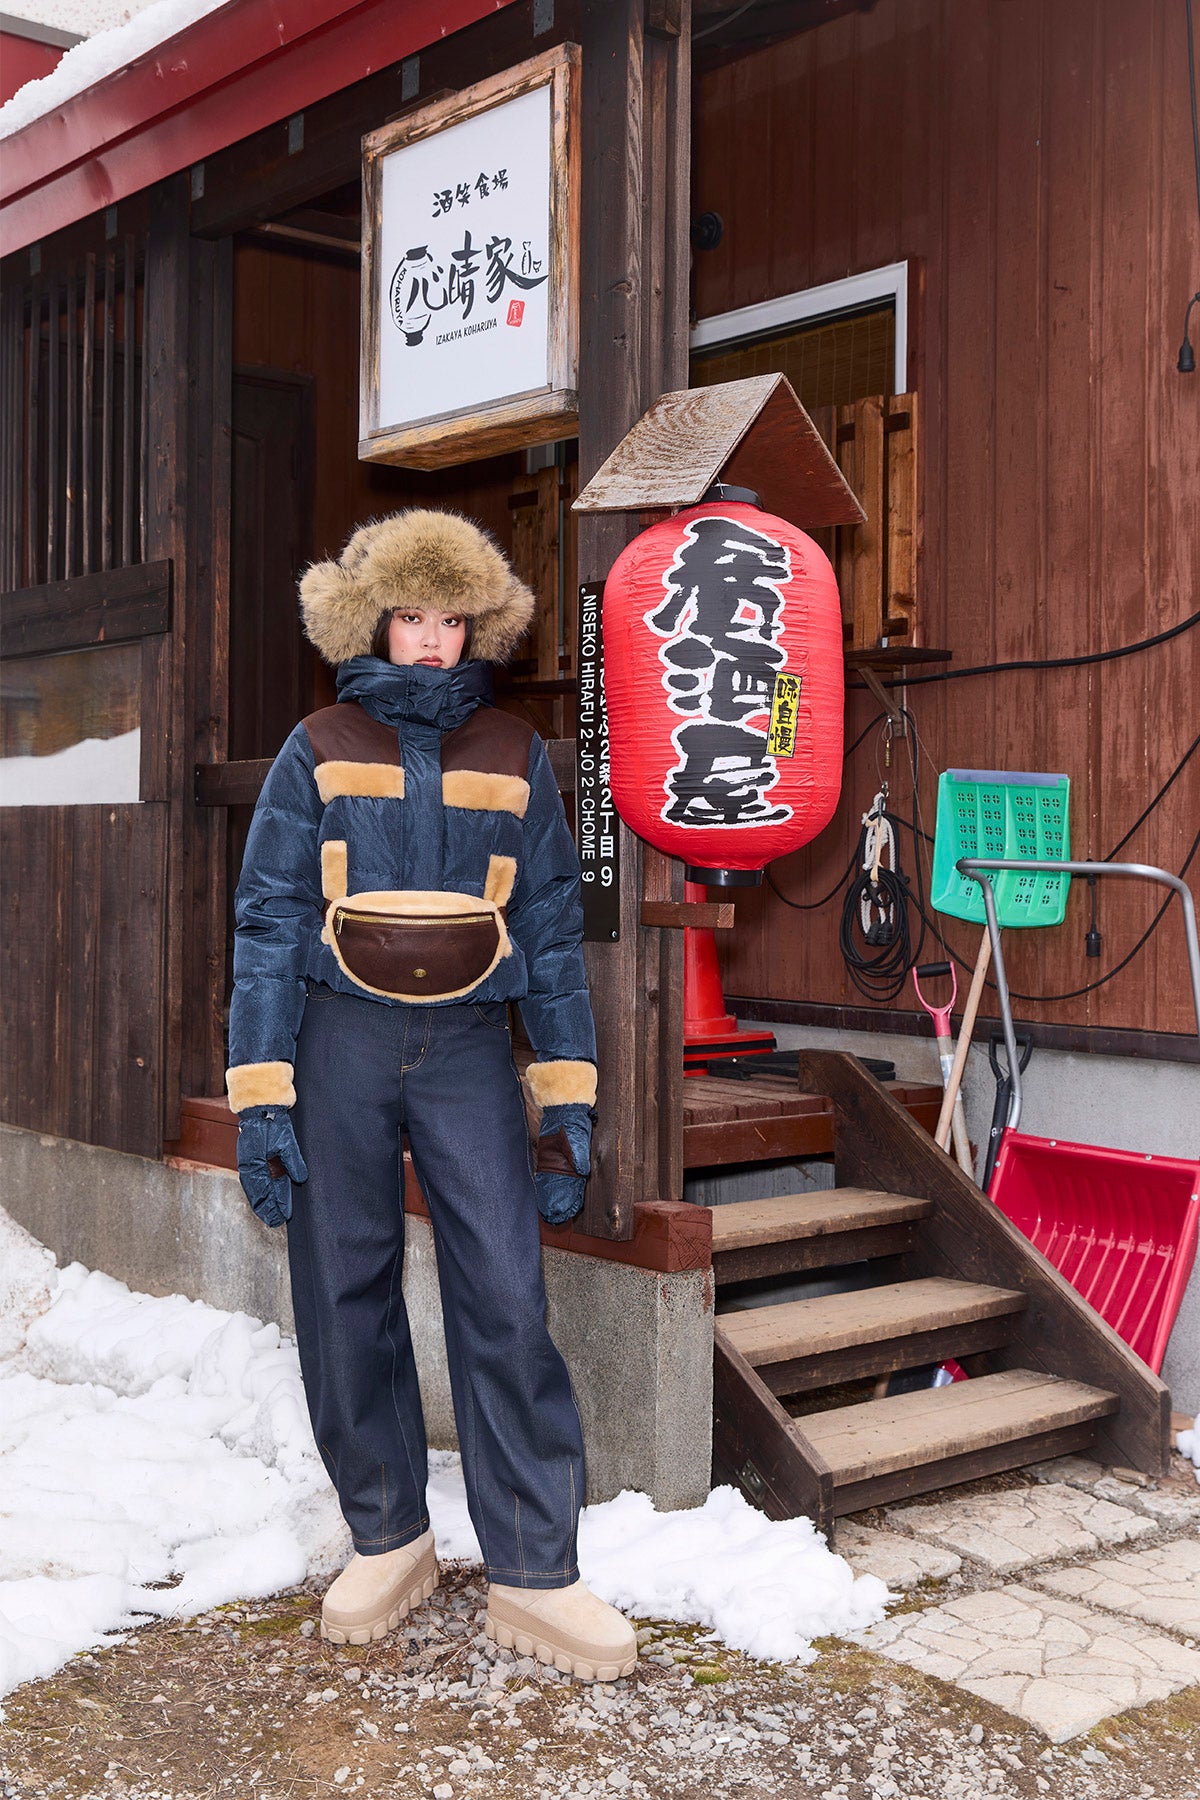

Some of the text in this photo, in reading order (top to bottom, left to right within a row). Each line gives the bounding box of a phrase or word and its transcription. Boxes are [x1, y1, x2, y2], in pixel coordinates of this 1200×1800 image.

[432, 169, 508, 217] 酒笑食場
[395, 267, 407, 326] KOHARUYA
[435, 318, 497, 345] IZAKAYA KOHARUYA
[645, 517, 792, 828] 居酒屋
[580, 594, 597, 883] NISEKO HIRAFU 2-JO 2-CHOME 9
[769, 678, 798, 753] 味自慢
[600, 865, 613, 888] 9
